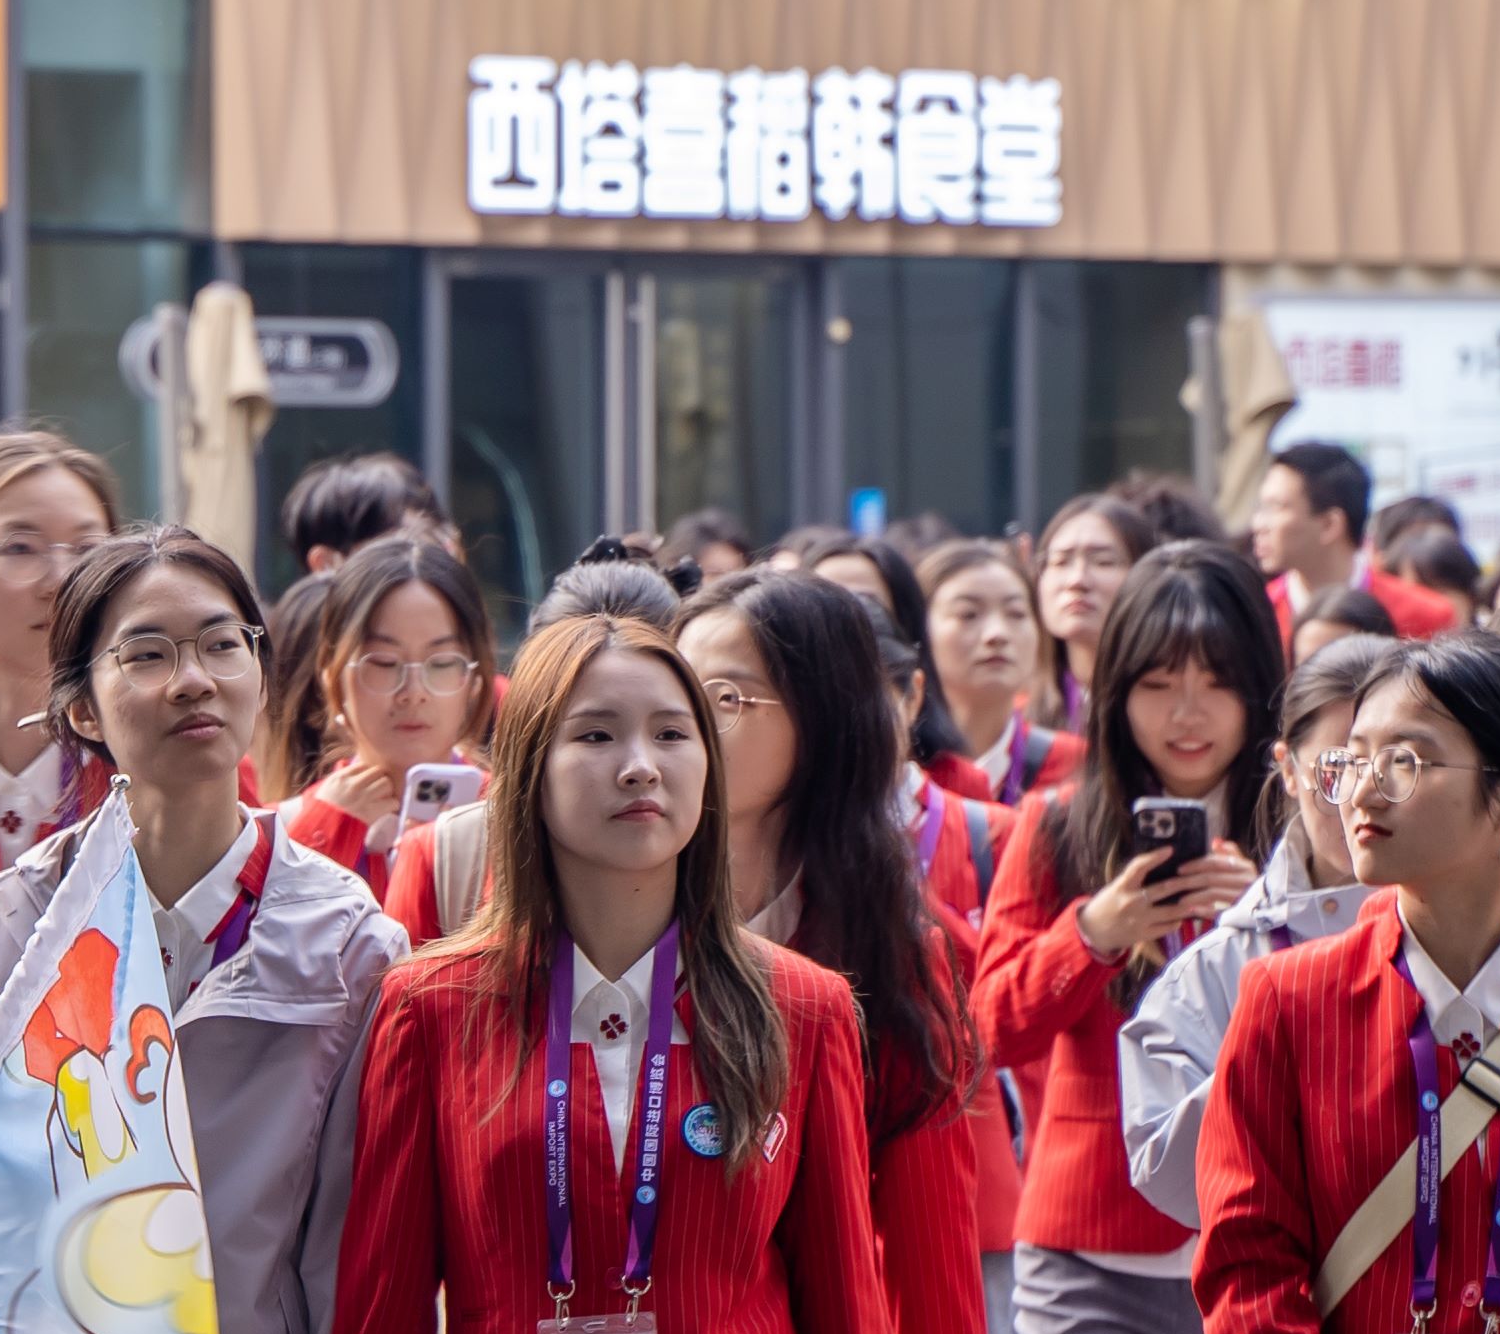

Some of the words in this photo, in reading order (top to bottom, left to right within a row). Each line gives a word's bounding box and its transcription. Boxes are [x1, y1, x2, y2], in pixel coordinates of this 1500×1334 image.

[556, 1100, 566, 1130] CHINA
[640, 1053, 666, 1182] 中国国际进口博览会
[548, 1121, 557, 1157] IMPORT
[548, 1160, 557, 1186] EXPO
[556, 1132, 567, 1208] INTERNATIONAL
